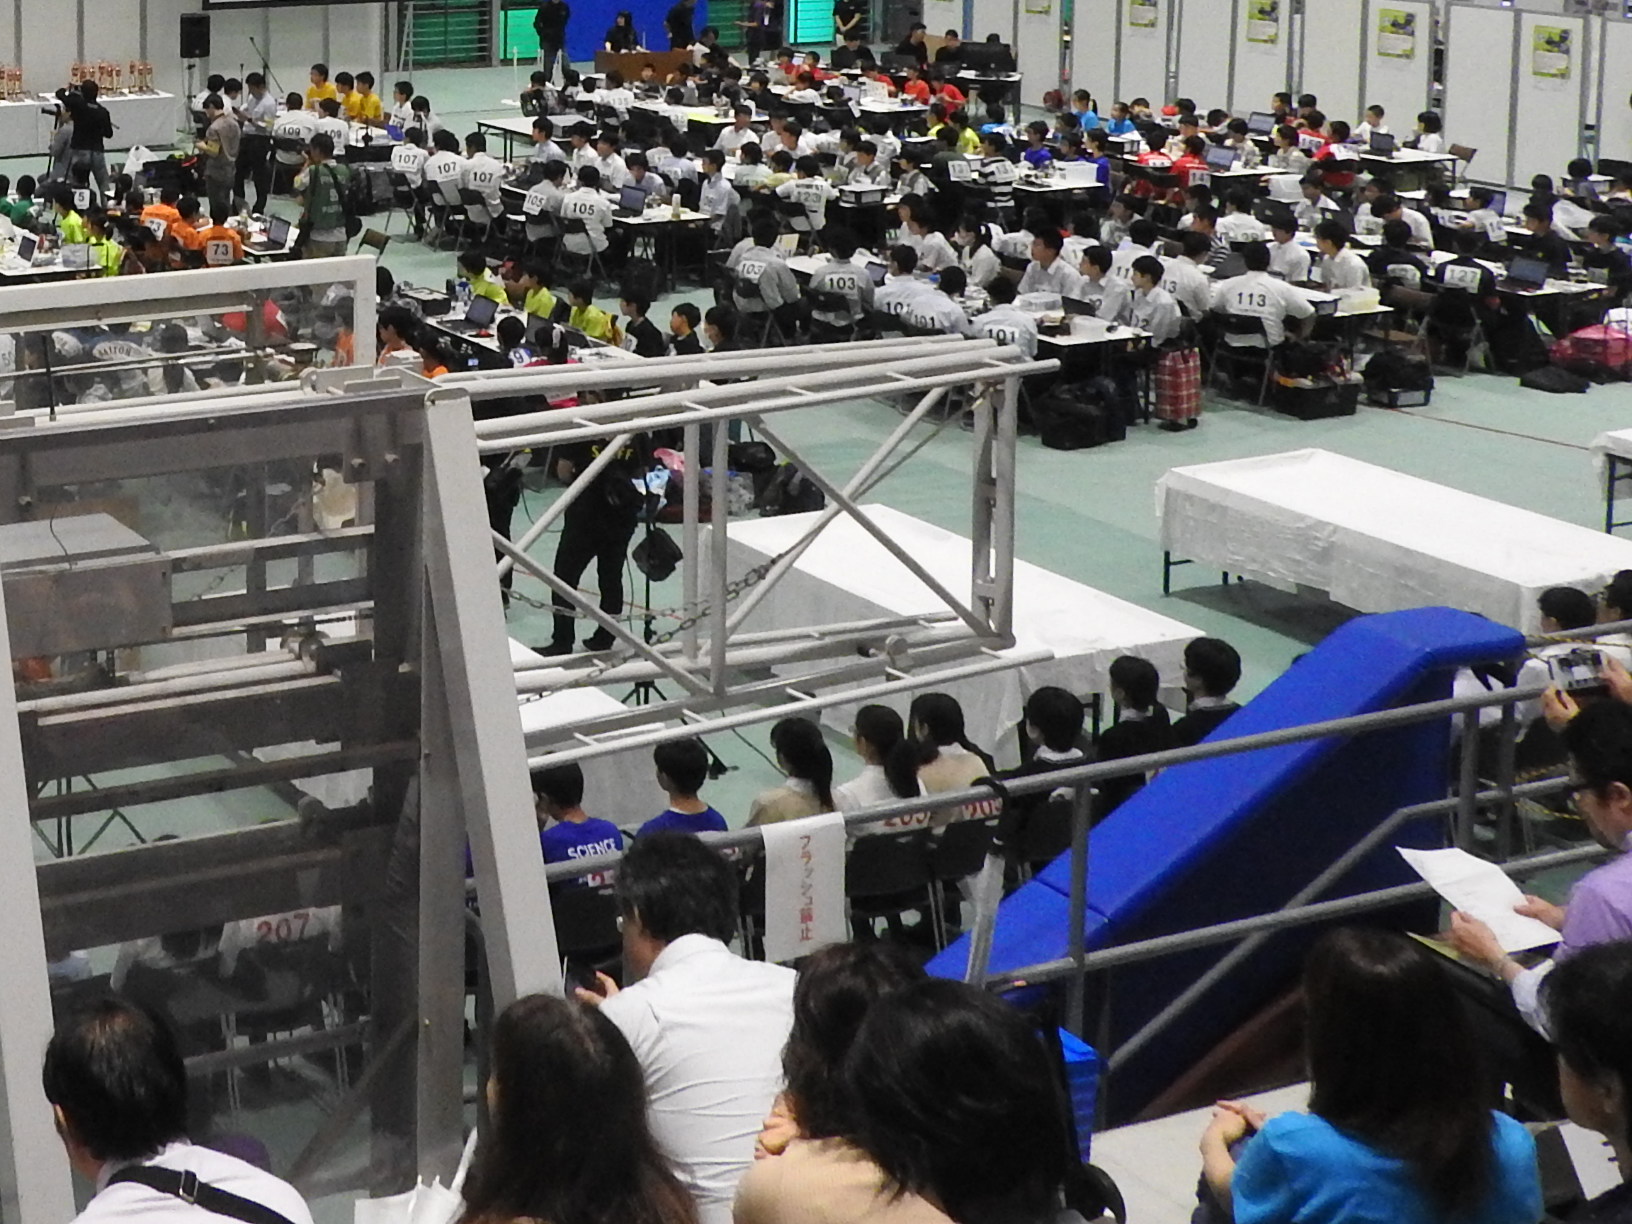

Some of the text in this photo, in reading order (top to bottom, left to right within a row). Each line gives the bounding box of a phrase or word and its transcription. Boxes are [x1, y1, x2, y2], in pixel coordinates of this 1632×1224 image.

[282, 126, 301, 137] 109
[398, 154, 418, 165] 107
[437, 161, 457, 174] 107
[472, 171, 493, 184] 107
[526, 194, 545, 208] 105
[572, 202, 596, 216] 105
[212, 243, 229, 256] 73
[740, 262, 765, 277] 103
[1448, 268, 1478, 283] 127
[828, 277, 856, 291] 103
[1237, 291, 1267, 308] 113
[986, 328, 1016, 345] 101
[591, 445, 634, 460] SFF
[567, 838, 616, 860] SCIENCE
[257, 913, 311, 942] 207
